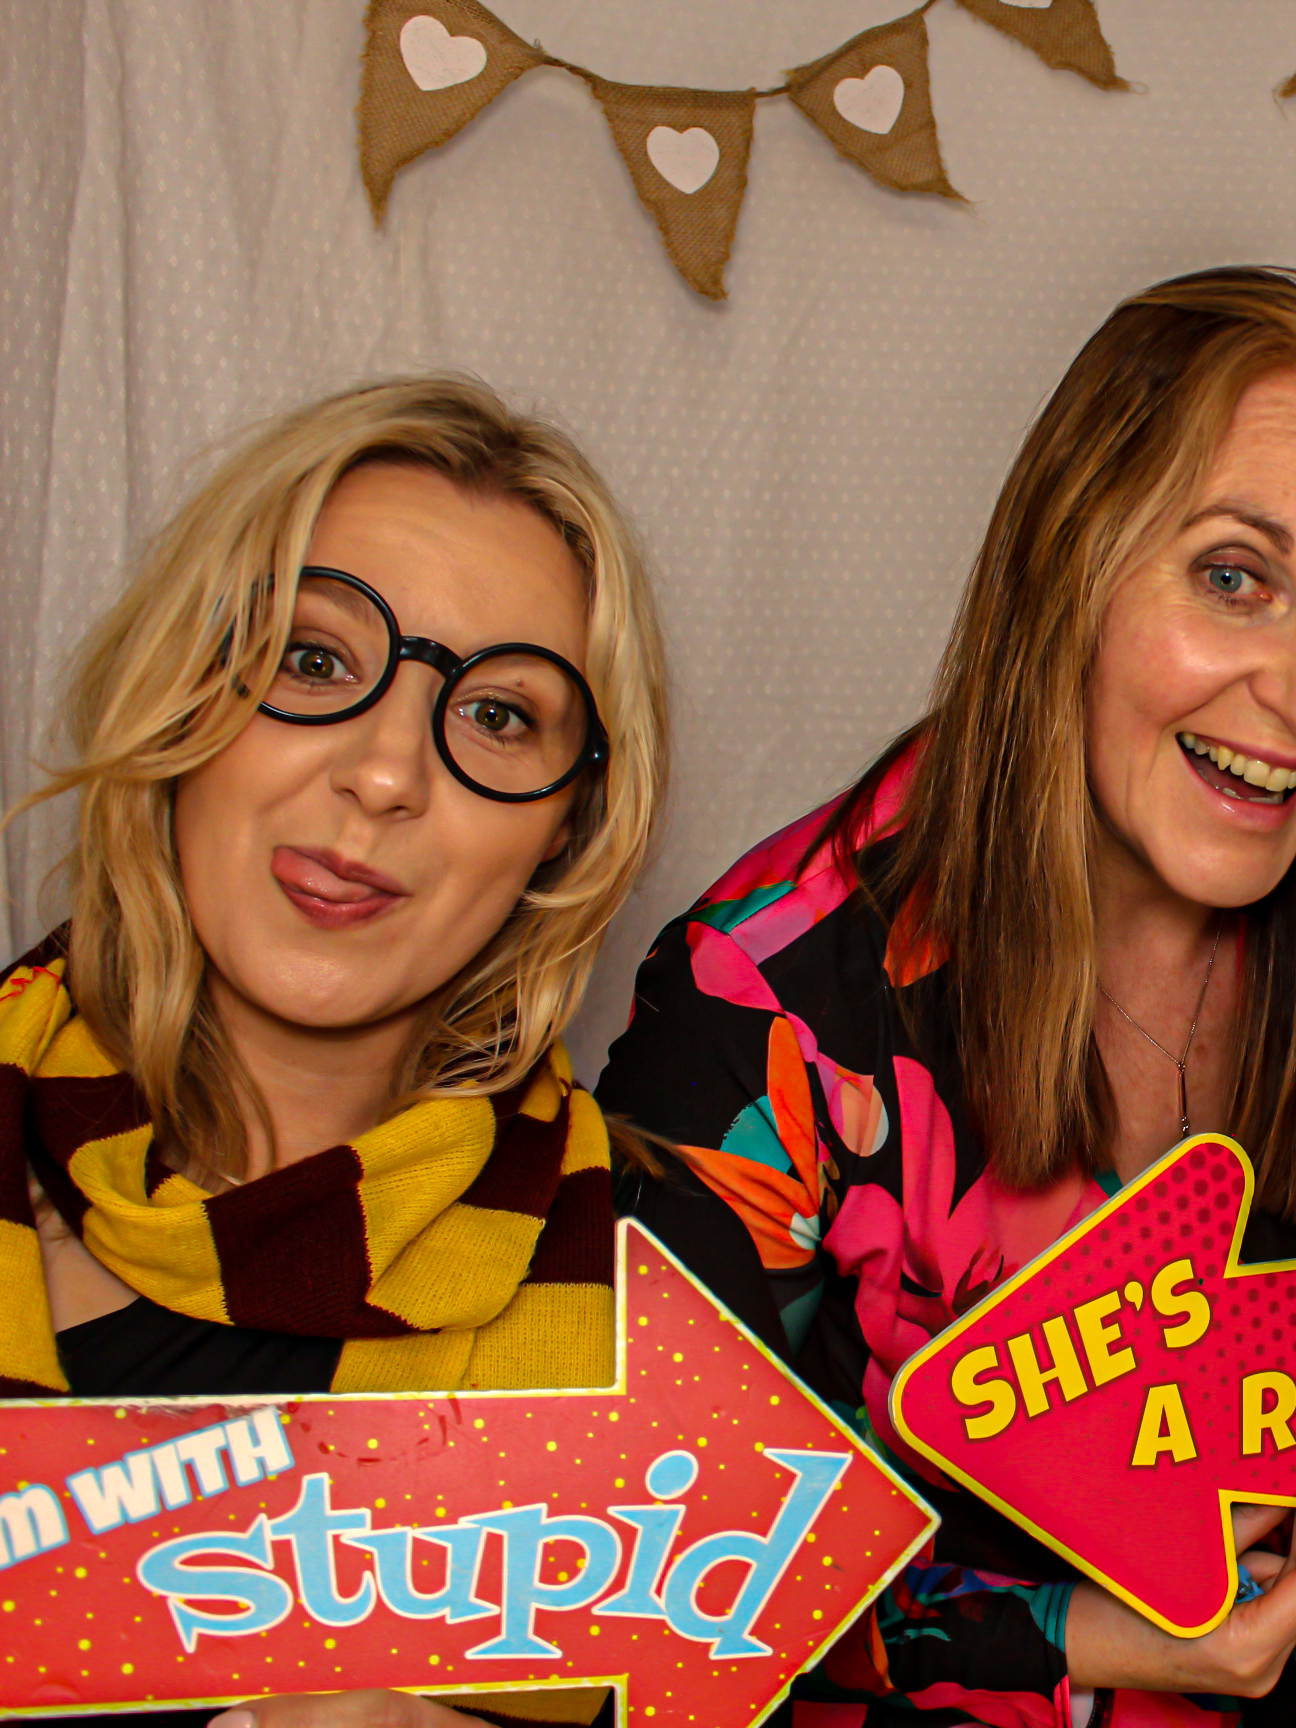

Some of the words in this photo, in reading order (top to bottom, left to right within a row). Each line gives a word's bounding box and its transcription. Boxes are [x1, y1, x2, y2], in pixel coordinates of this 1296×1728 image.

[949, 1257, 1212, 1441] SHE'S
[1129, 1382, 1199, 1467] A
[65, 1406, 295, 1535] WITH
[137, 1448, 853, 1659] stupid
